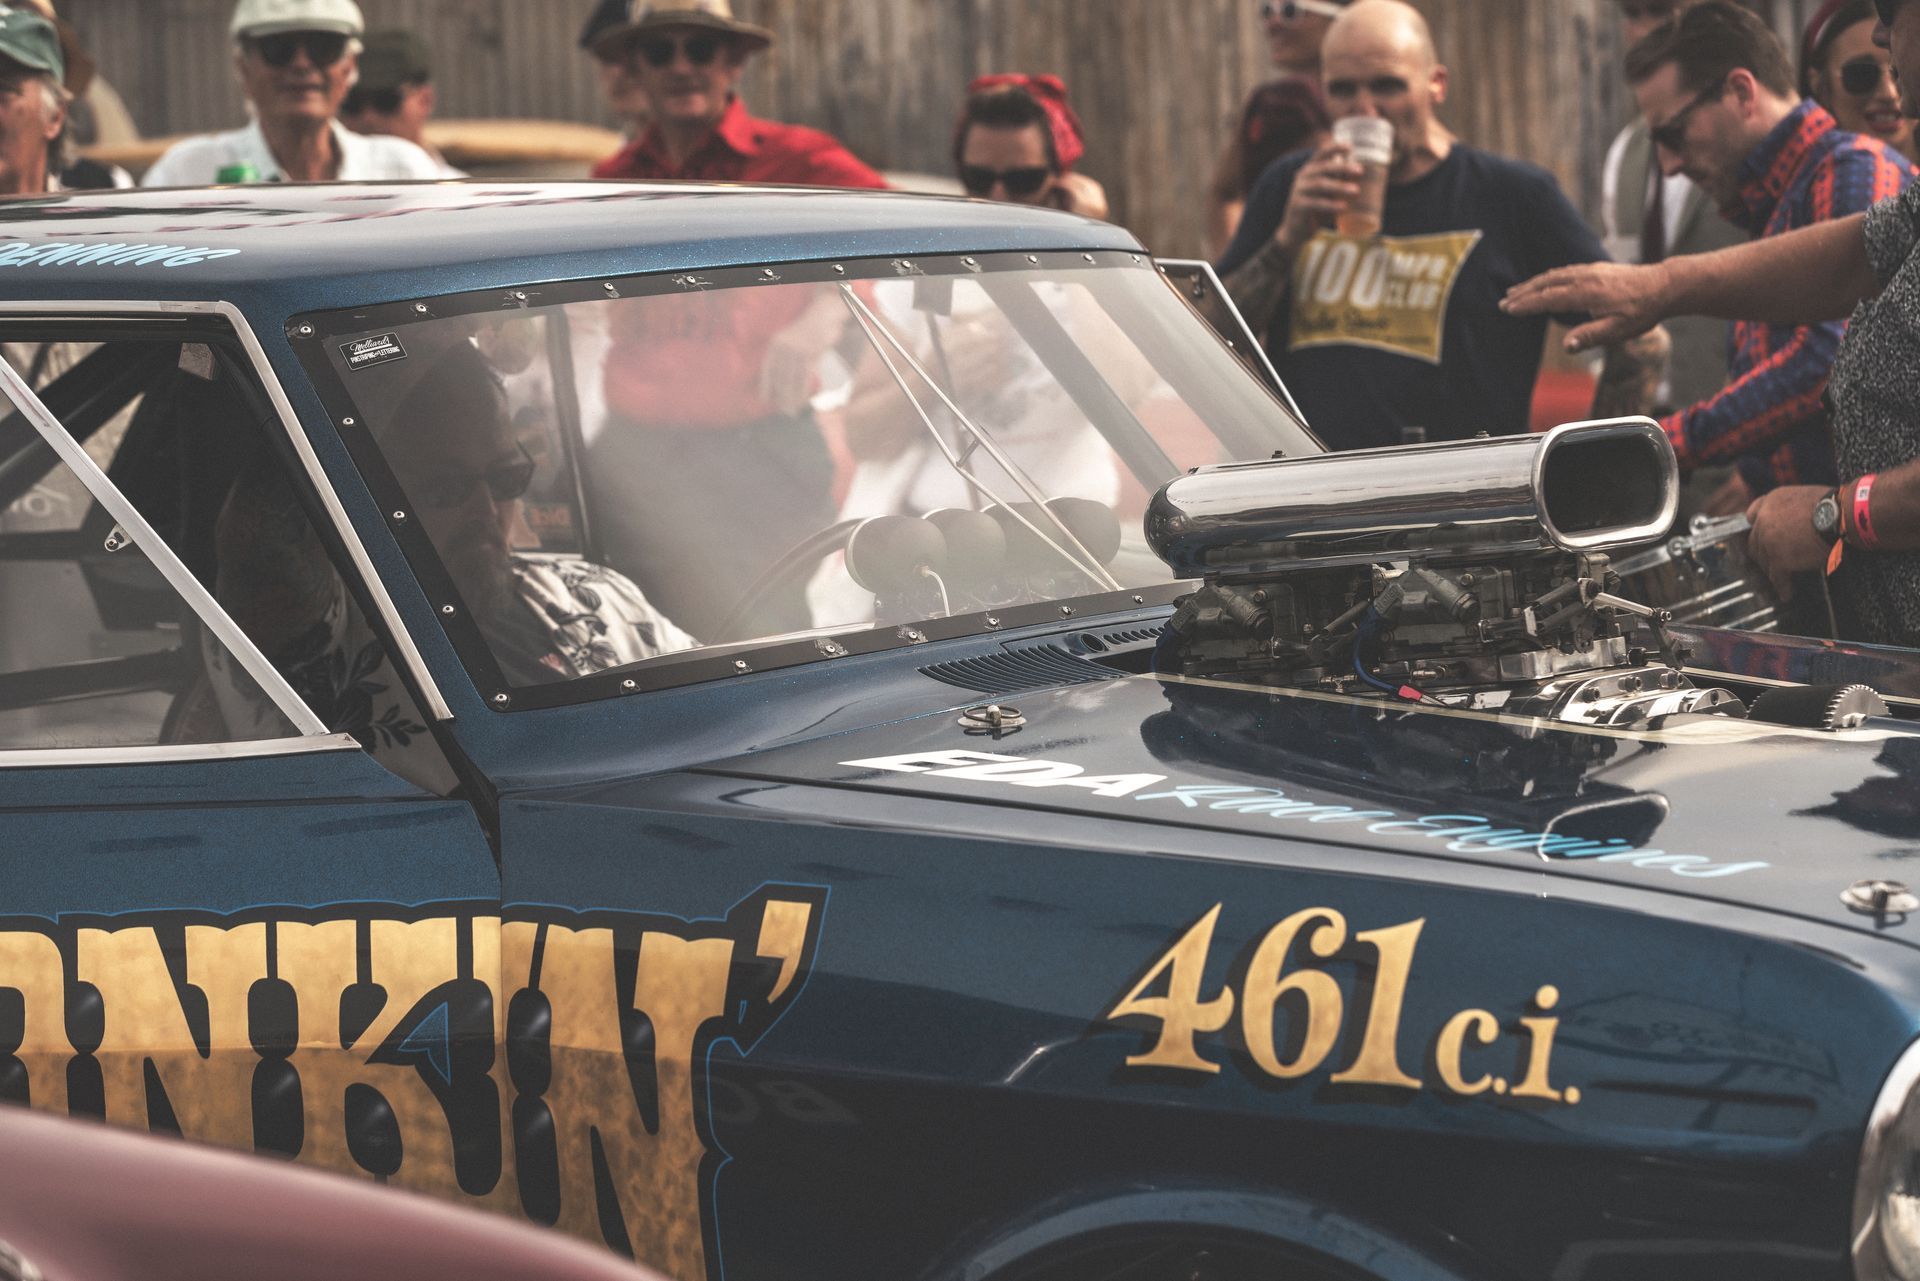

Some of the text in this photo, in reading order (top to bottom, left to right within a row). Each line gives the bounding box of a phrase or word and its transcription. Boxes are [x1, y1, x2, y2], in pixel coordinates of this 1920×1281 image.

[1299, 238, 1389, 310] 100
[837, 749, 1770, 878] EDA Race Engines
[1106, 902, 1581, 1104] 461 c.i.
